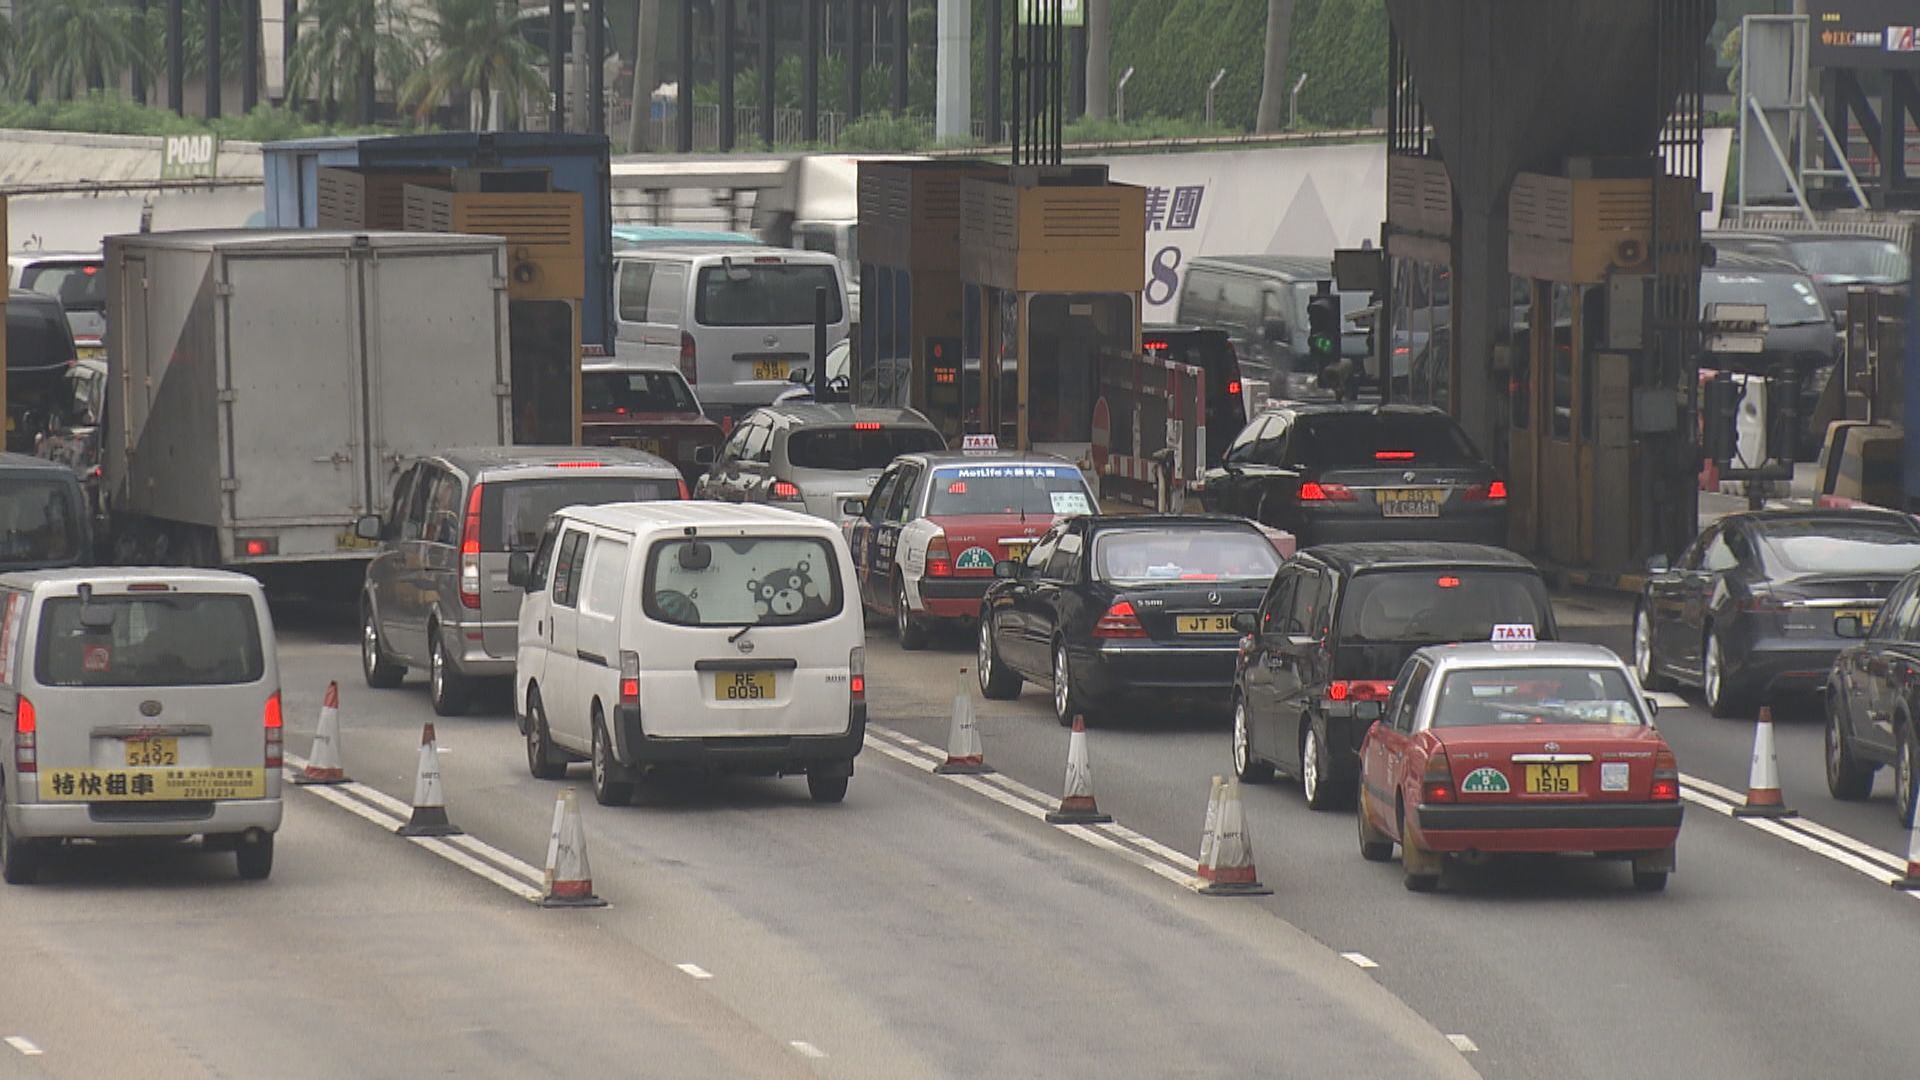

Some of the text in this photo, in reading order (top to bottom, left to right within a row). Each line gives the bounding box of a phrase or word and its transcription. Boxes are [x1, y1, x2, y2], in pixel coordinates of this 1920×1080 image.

[167, 135, 212, 165] POAD
[1145, 246, 1182, 306] 8
[966, 437, 995, 447] TAXI
[959, 468, 1001, 478] MetLife
[1190, 617, 1233, 631] JT 31
[1497, 627, 1532, 639] TAXI
[735, 673, 756, 686] RE
[129, 752, 176, 766] 5492
[1536, 778, 1569, 792] 1519
